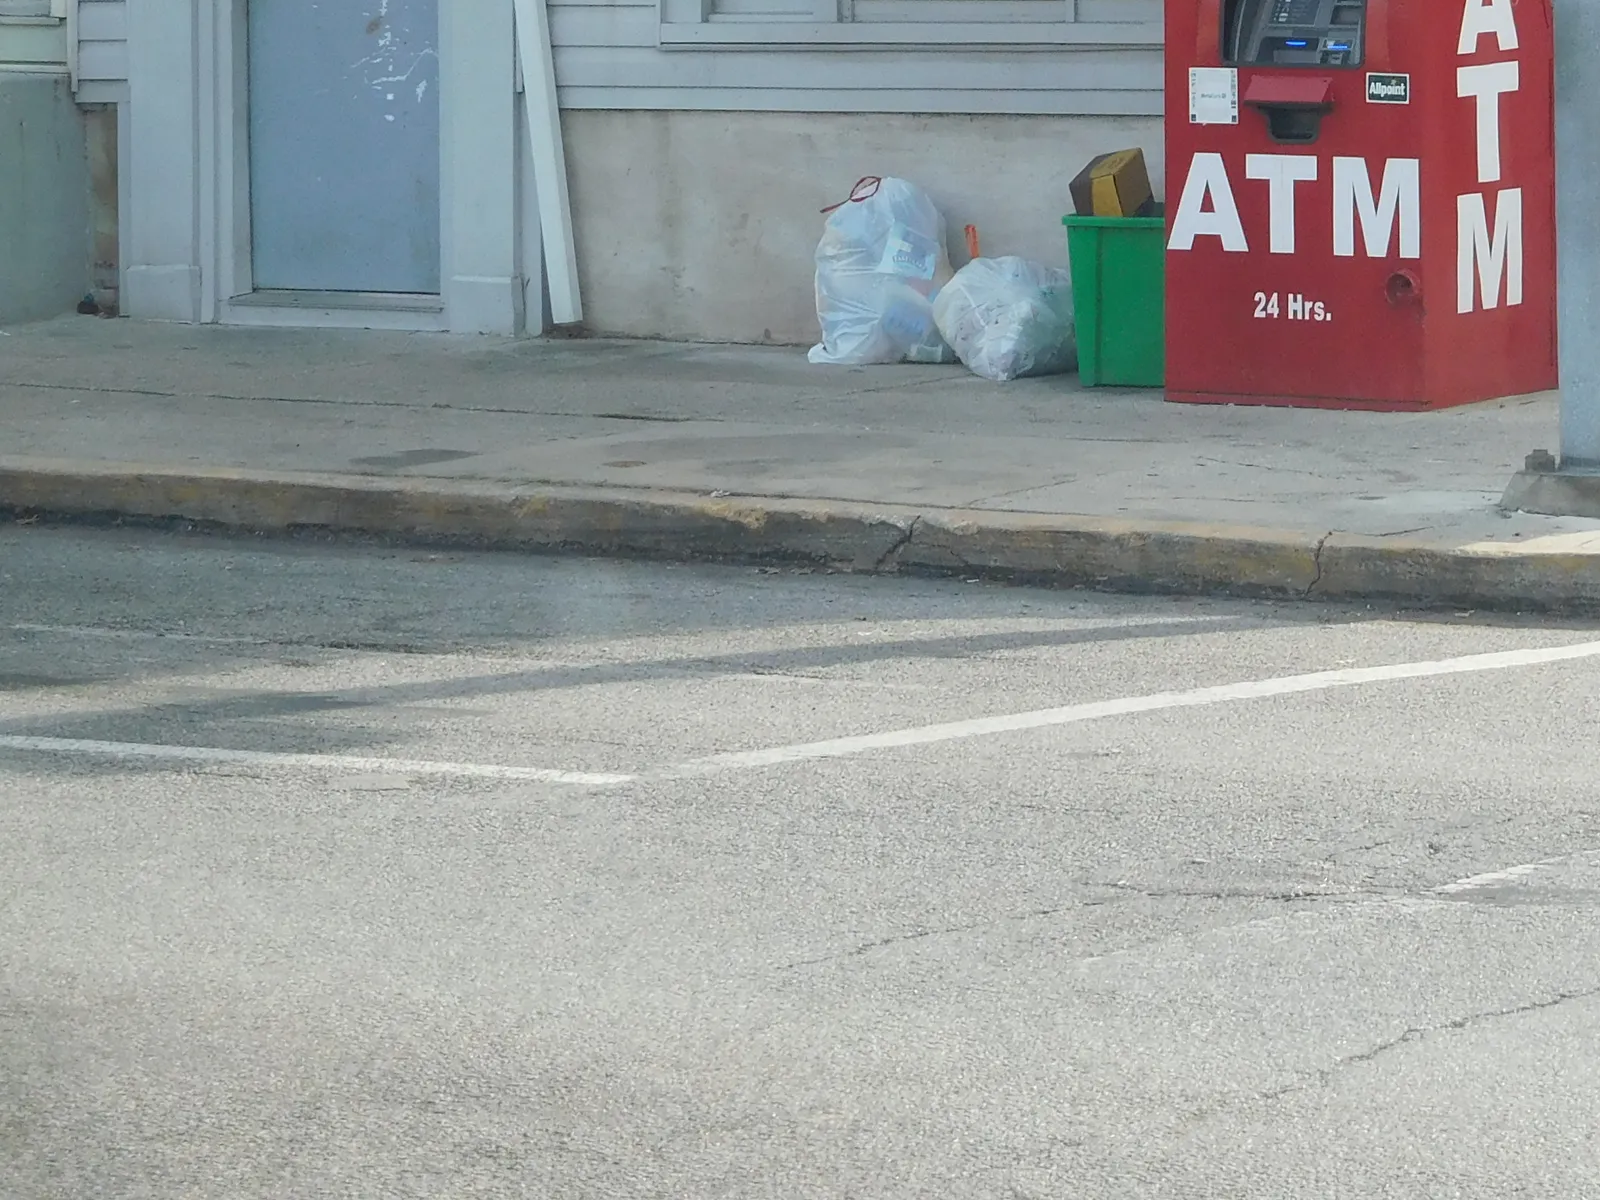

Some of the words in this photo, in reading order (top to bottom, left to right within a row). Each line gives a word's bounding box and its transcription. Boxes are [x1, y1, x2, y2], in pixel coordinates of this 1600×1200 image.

[1369, 80, 1406, 98] Allpoint
[1166, 152, 1421, 259] ATM
[1253, 291, 1280, 318] 24
[1287, 293, 1332, 321] Hrs.
